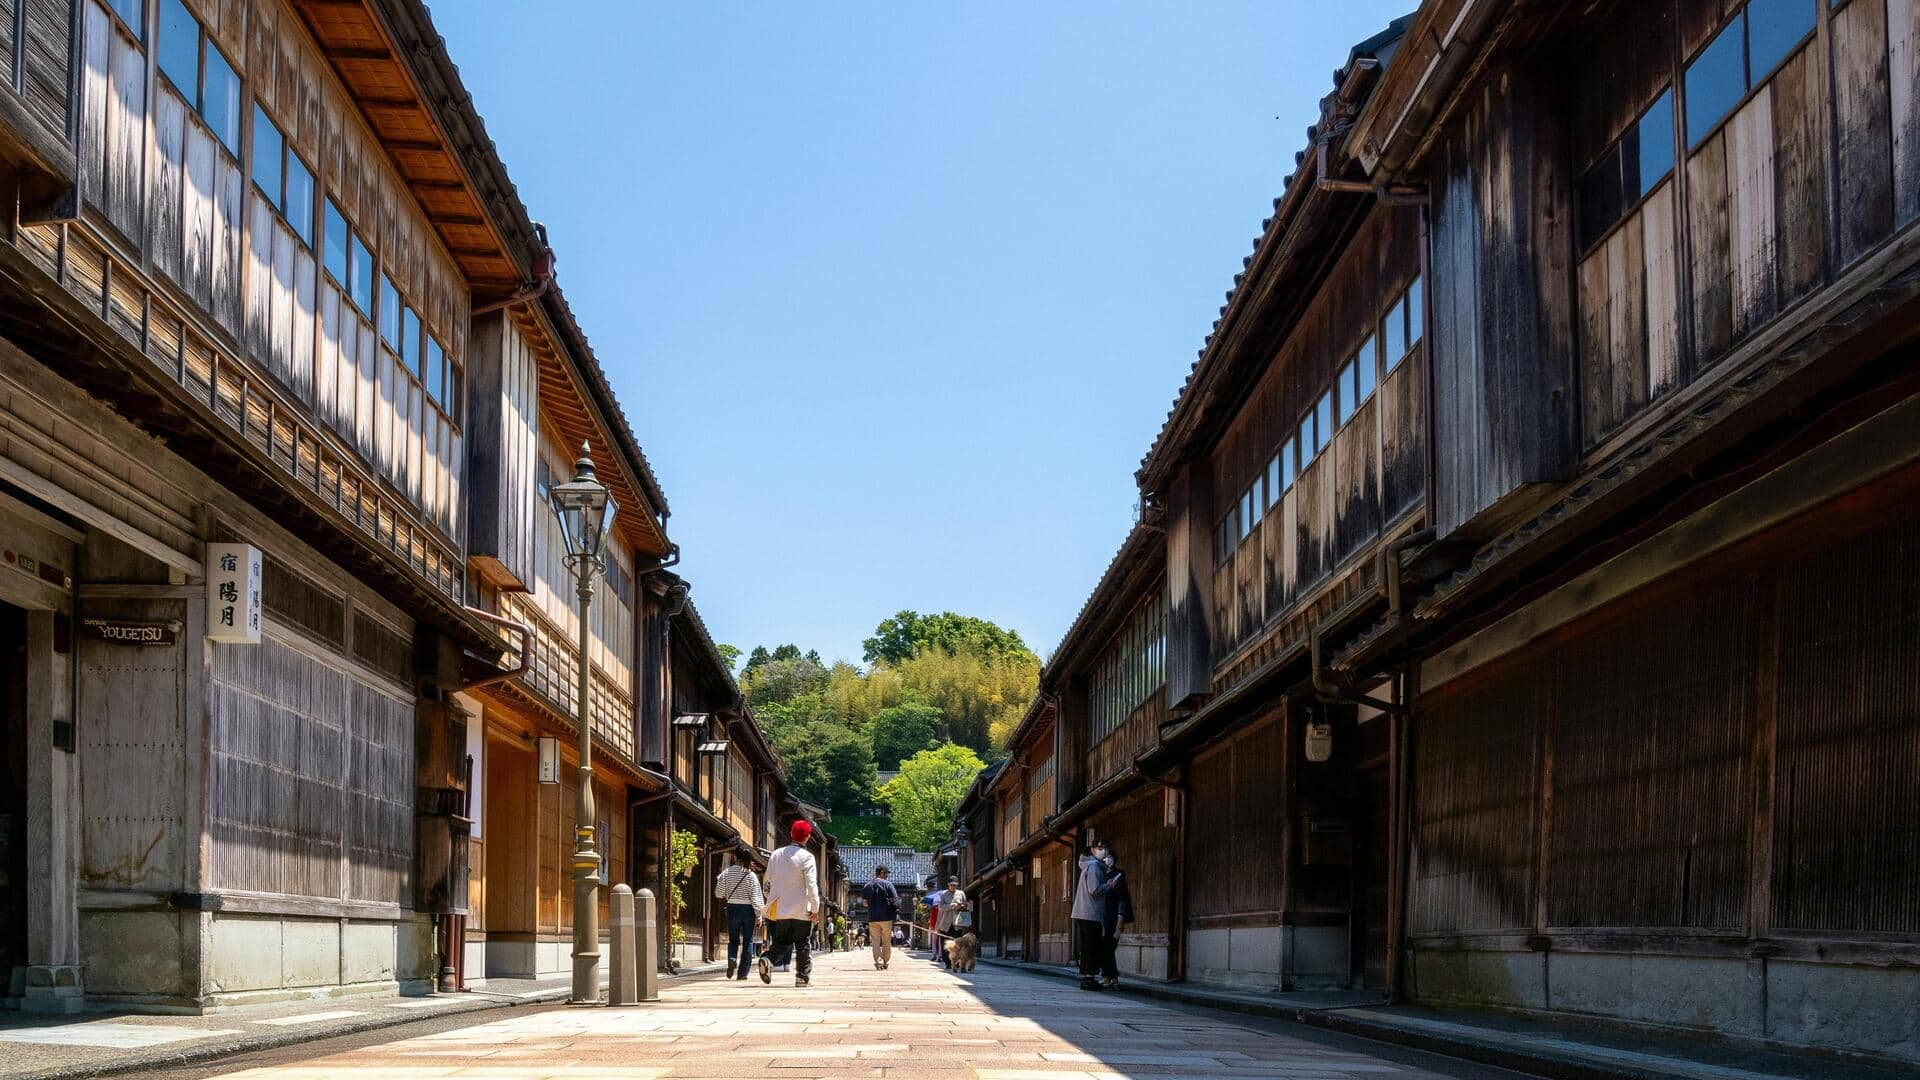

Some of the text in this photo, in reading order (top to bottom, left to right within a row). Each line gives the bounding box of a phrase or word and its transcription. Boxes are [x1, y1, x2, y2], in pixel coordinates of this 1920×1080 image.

[219, 553, 239, 627] 宿陽月
[97, 625, 162, 641] YOUGETSU
